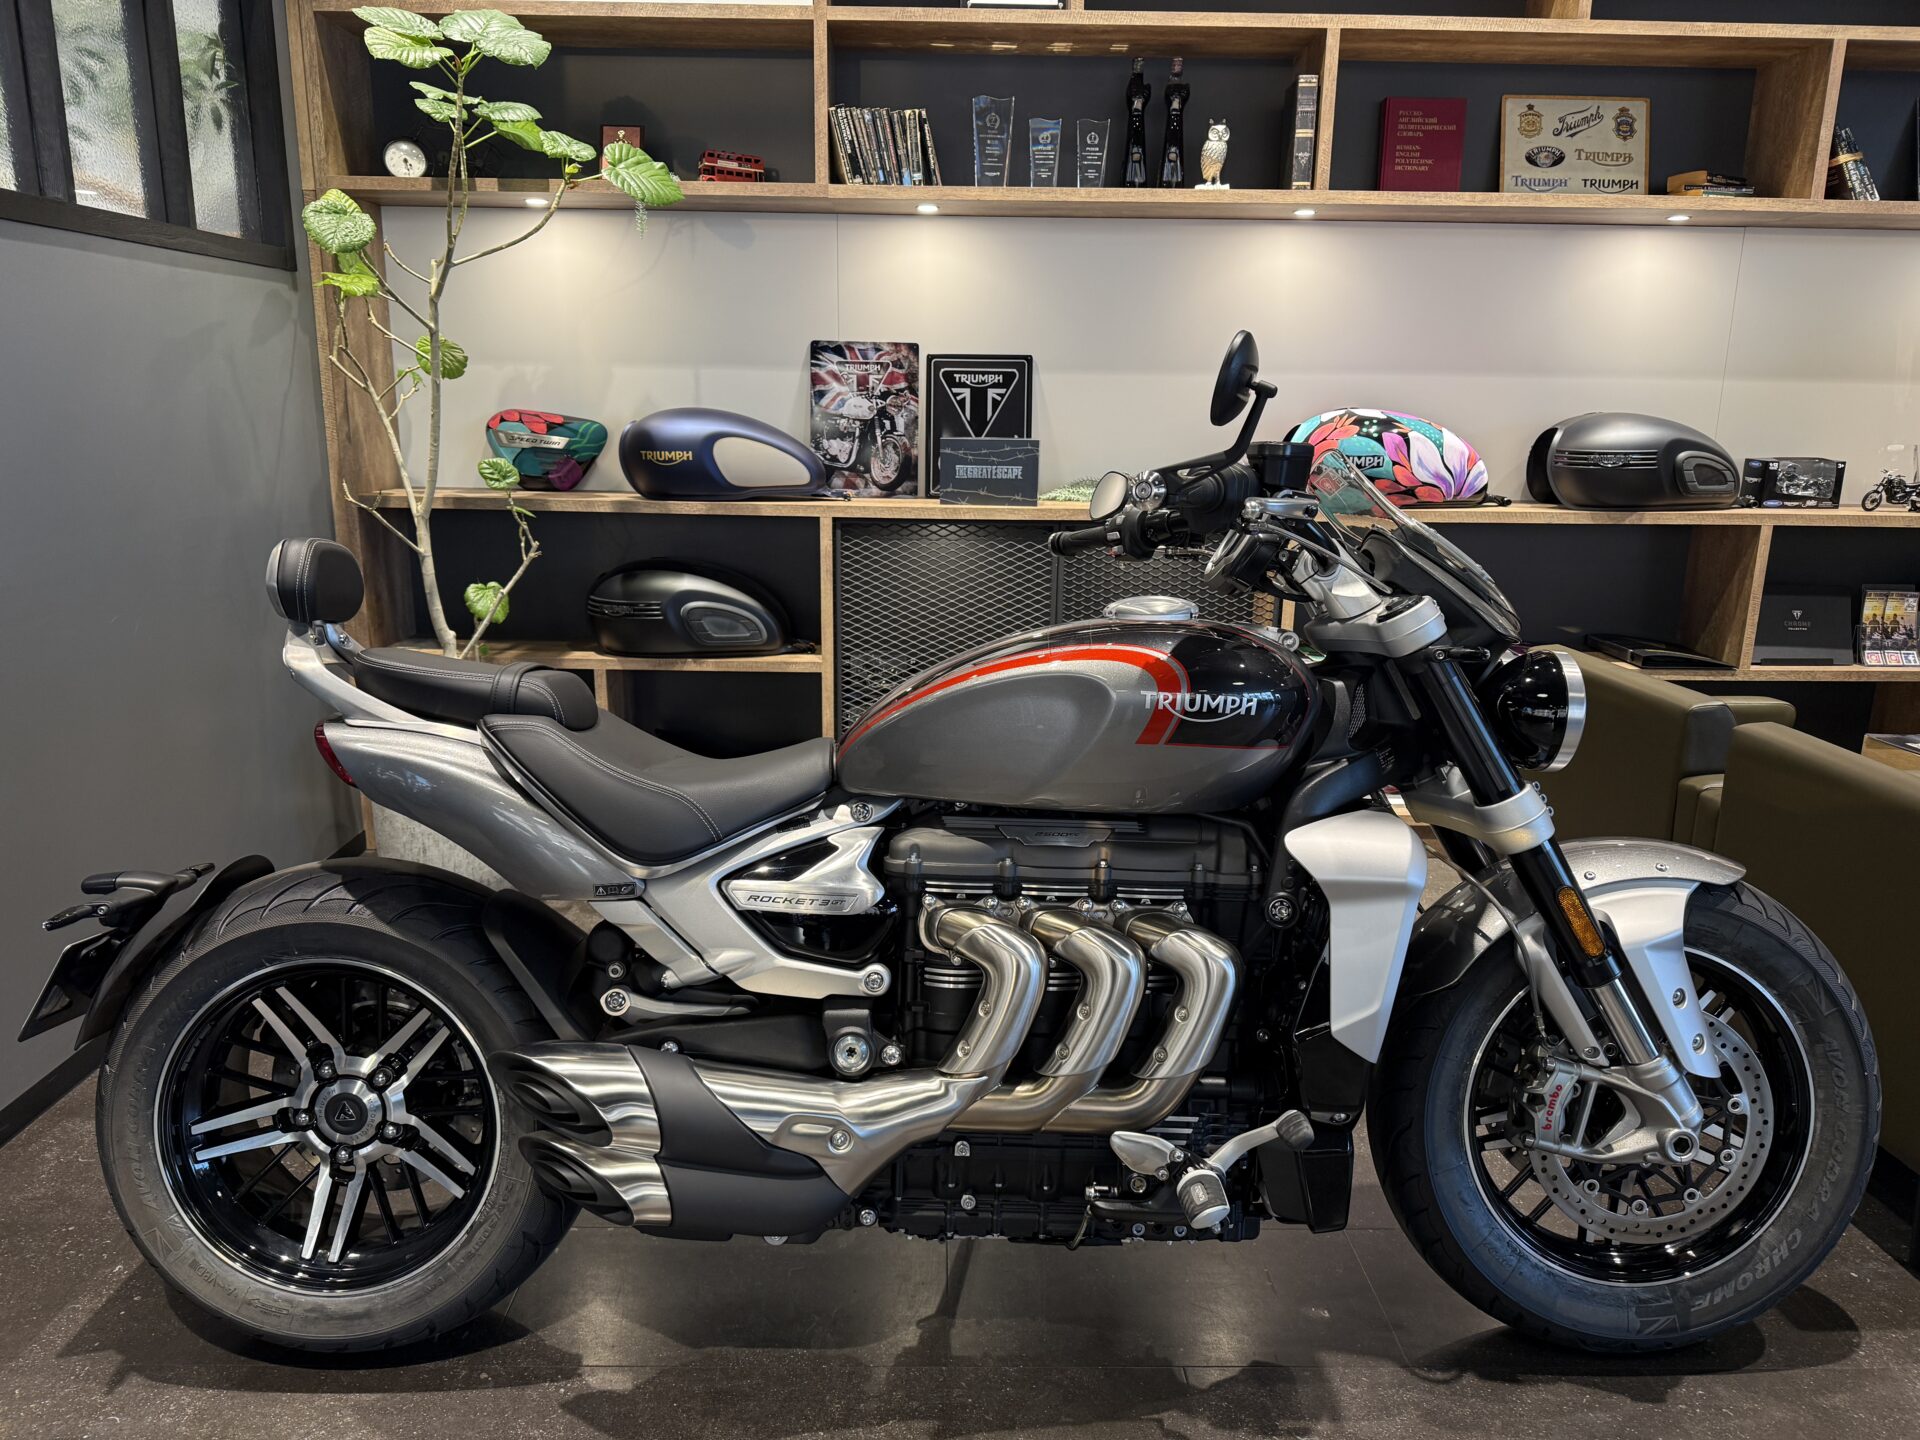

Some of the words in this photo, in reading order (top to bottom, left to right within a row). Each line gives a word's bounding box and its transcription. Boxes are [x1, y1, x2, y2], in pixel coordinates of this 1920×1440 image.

[1552, 105, 1604, 139] Triumph
[1528, 146, 1561, 157] TRIUMPH
[1574, 148, 1634, 167] TRIUMPH
[1511, 175, 1569, 193] TRIUMPH
[1581, 178, 1639, 194] TRIUMPH
[845, 363, 881, 373] TRIUMPH
[953, 373, 1003, 387] TRIUMPH
[509, 435, 537, 444] SPEED
[640, 450, 693, 465] TRIUMPH
[1140, 690, 1258, 722] TRIUMPH
[1541, 1084, 1563, 1131] brembo
[1690, 1228, 1802, 1312] CHROME
